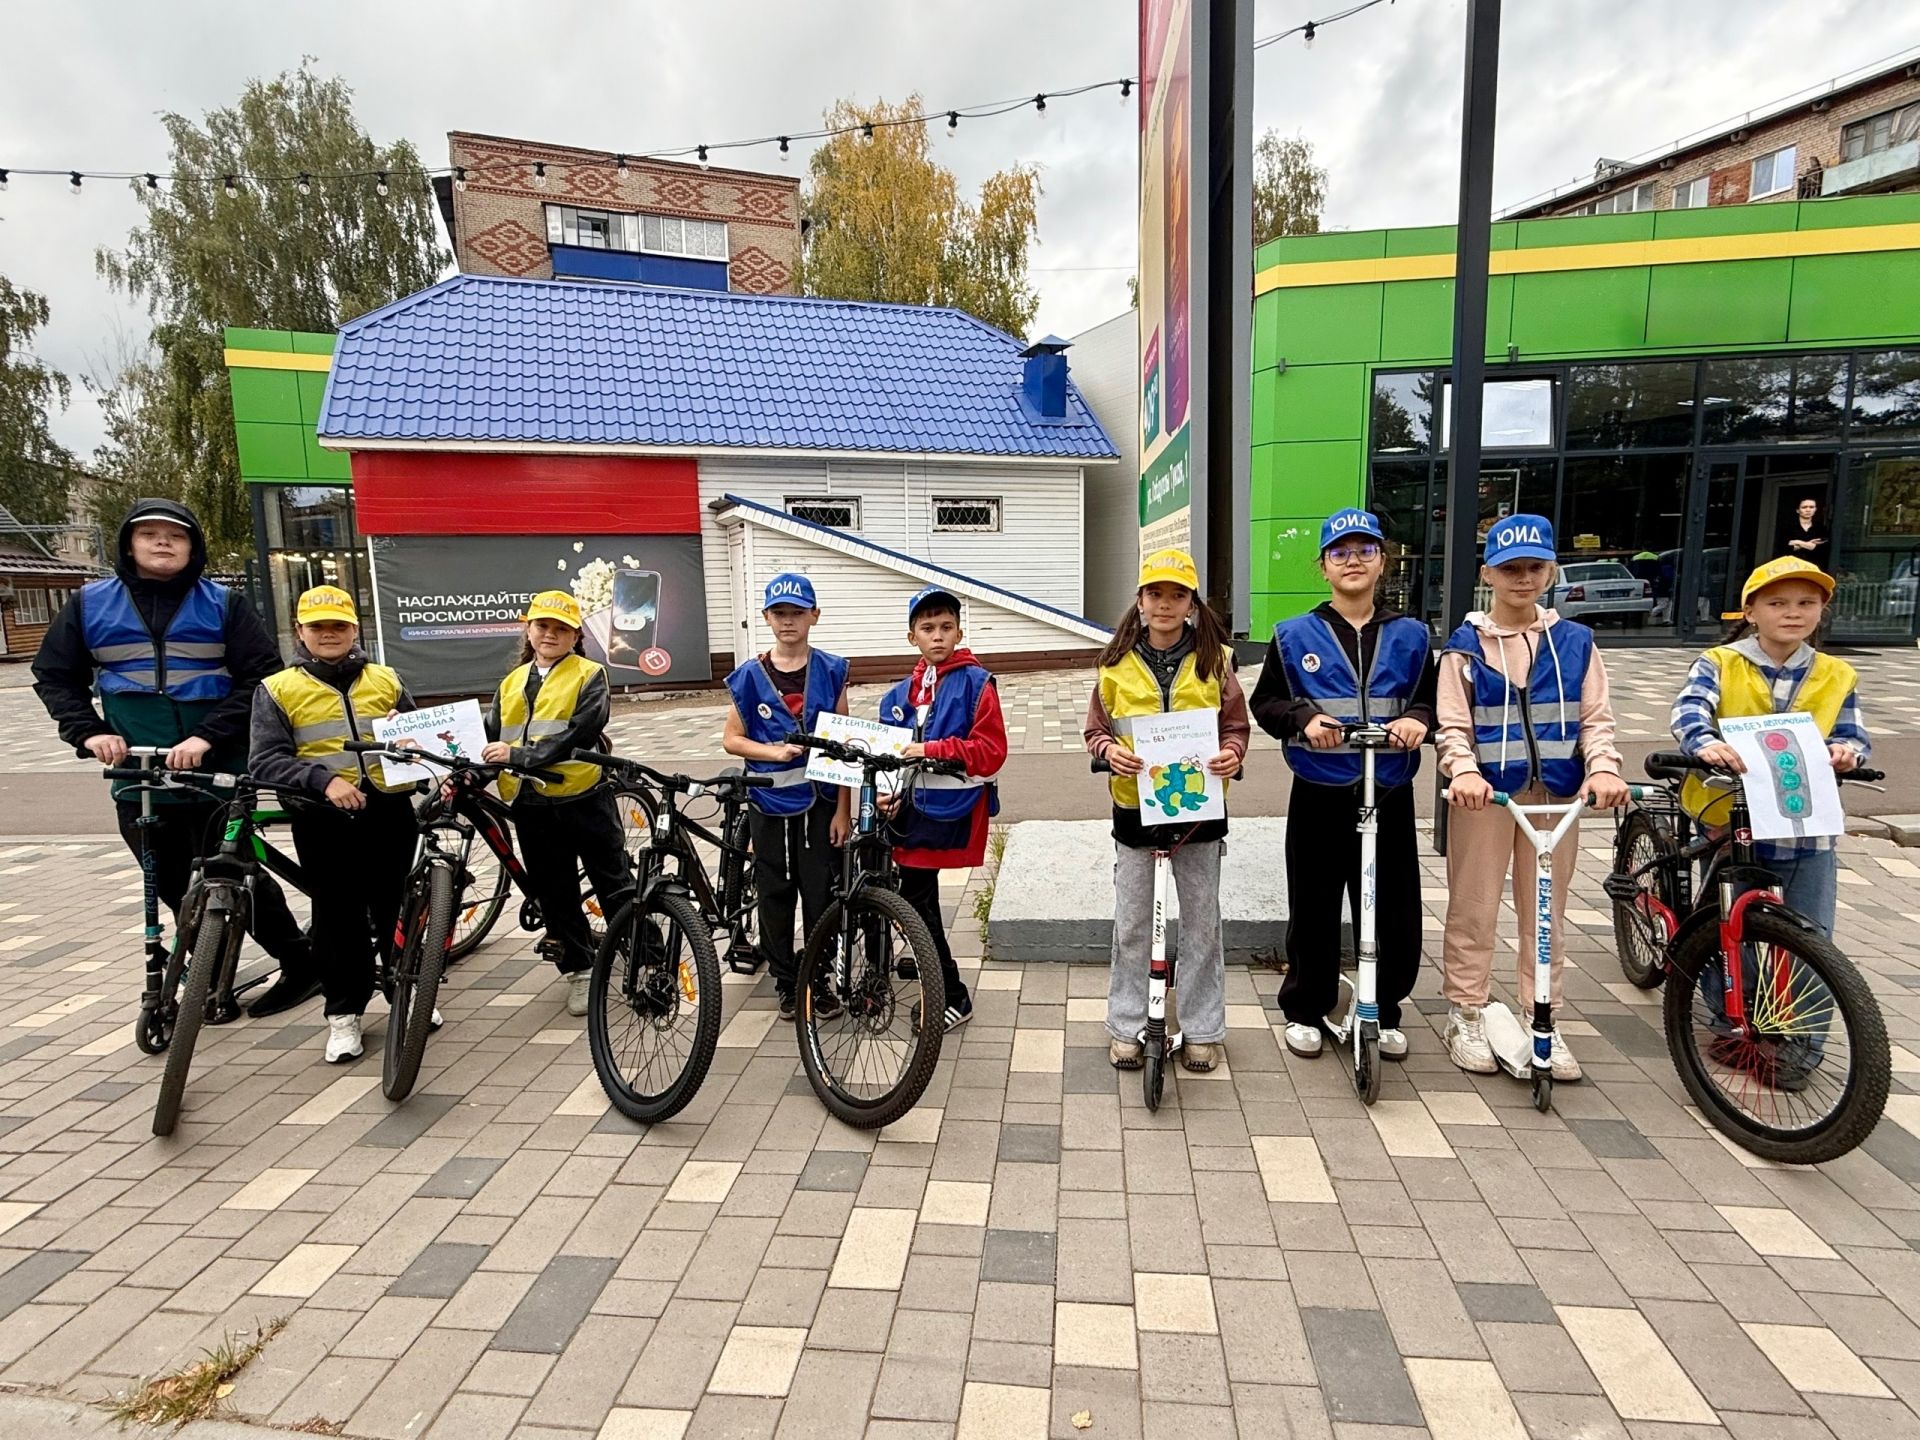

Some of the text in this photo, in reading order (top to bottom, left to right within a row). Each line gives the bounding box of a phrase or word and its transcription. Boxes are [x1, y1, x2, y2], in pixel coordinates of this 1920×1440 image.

[1330, 514, 1370, 535] ЮИД
[1496, 525, 1543, 550] ЮИД
[770, 580, 803, 598] ЮИД
[308, 594, 345, 608] ЮИД
[397, 592, 537, 607] НАСЛАЖДАЙТЕС
[540, 597, 571, 614] ЮИД
[399, 609, 523, 623] ПРОСМОТРОМ
[395, 705, 455, 727] ДЕНЬ БЕЗ
[382, 716, 455, 738] АВТОМОБИЛЯ
[831, 716, 890, 735] 22 СЕНТЯБРЯ
[1744, 721, 1762, 731] БЕЗ
[806, 769, 825, 778] ДЕНЬ
[827, 772, 841, 781] БЕЗ
